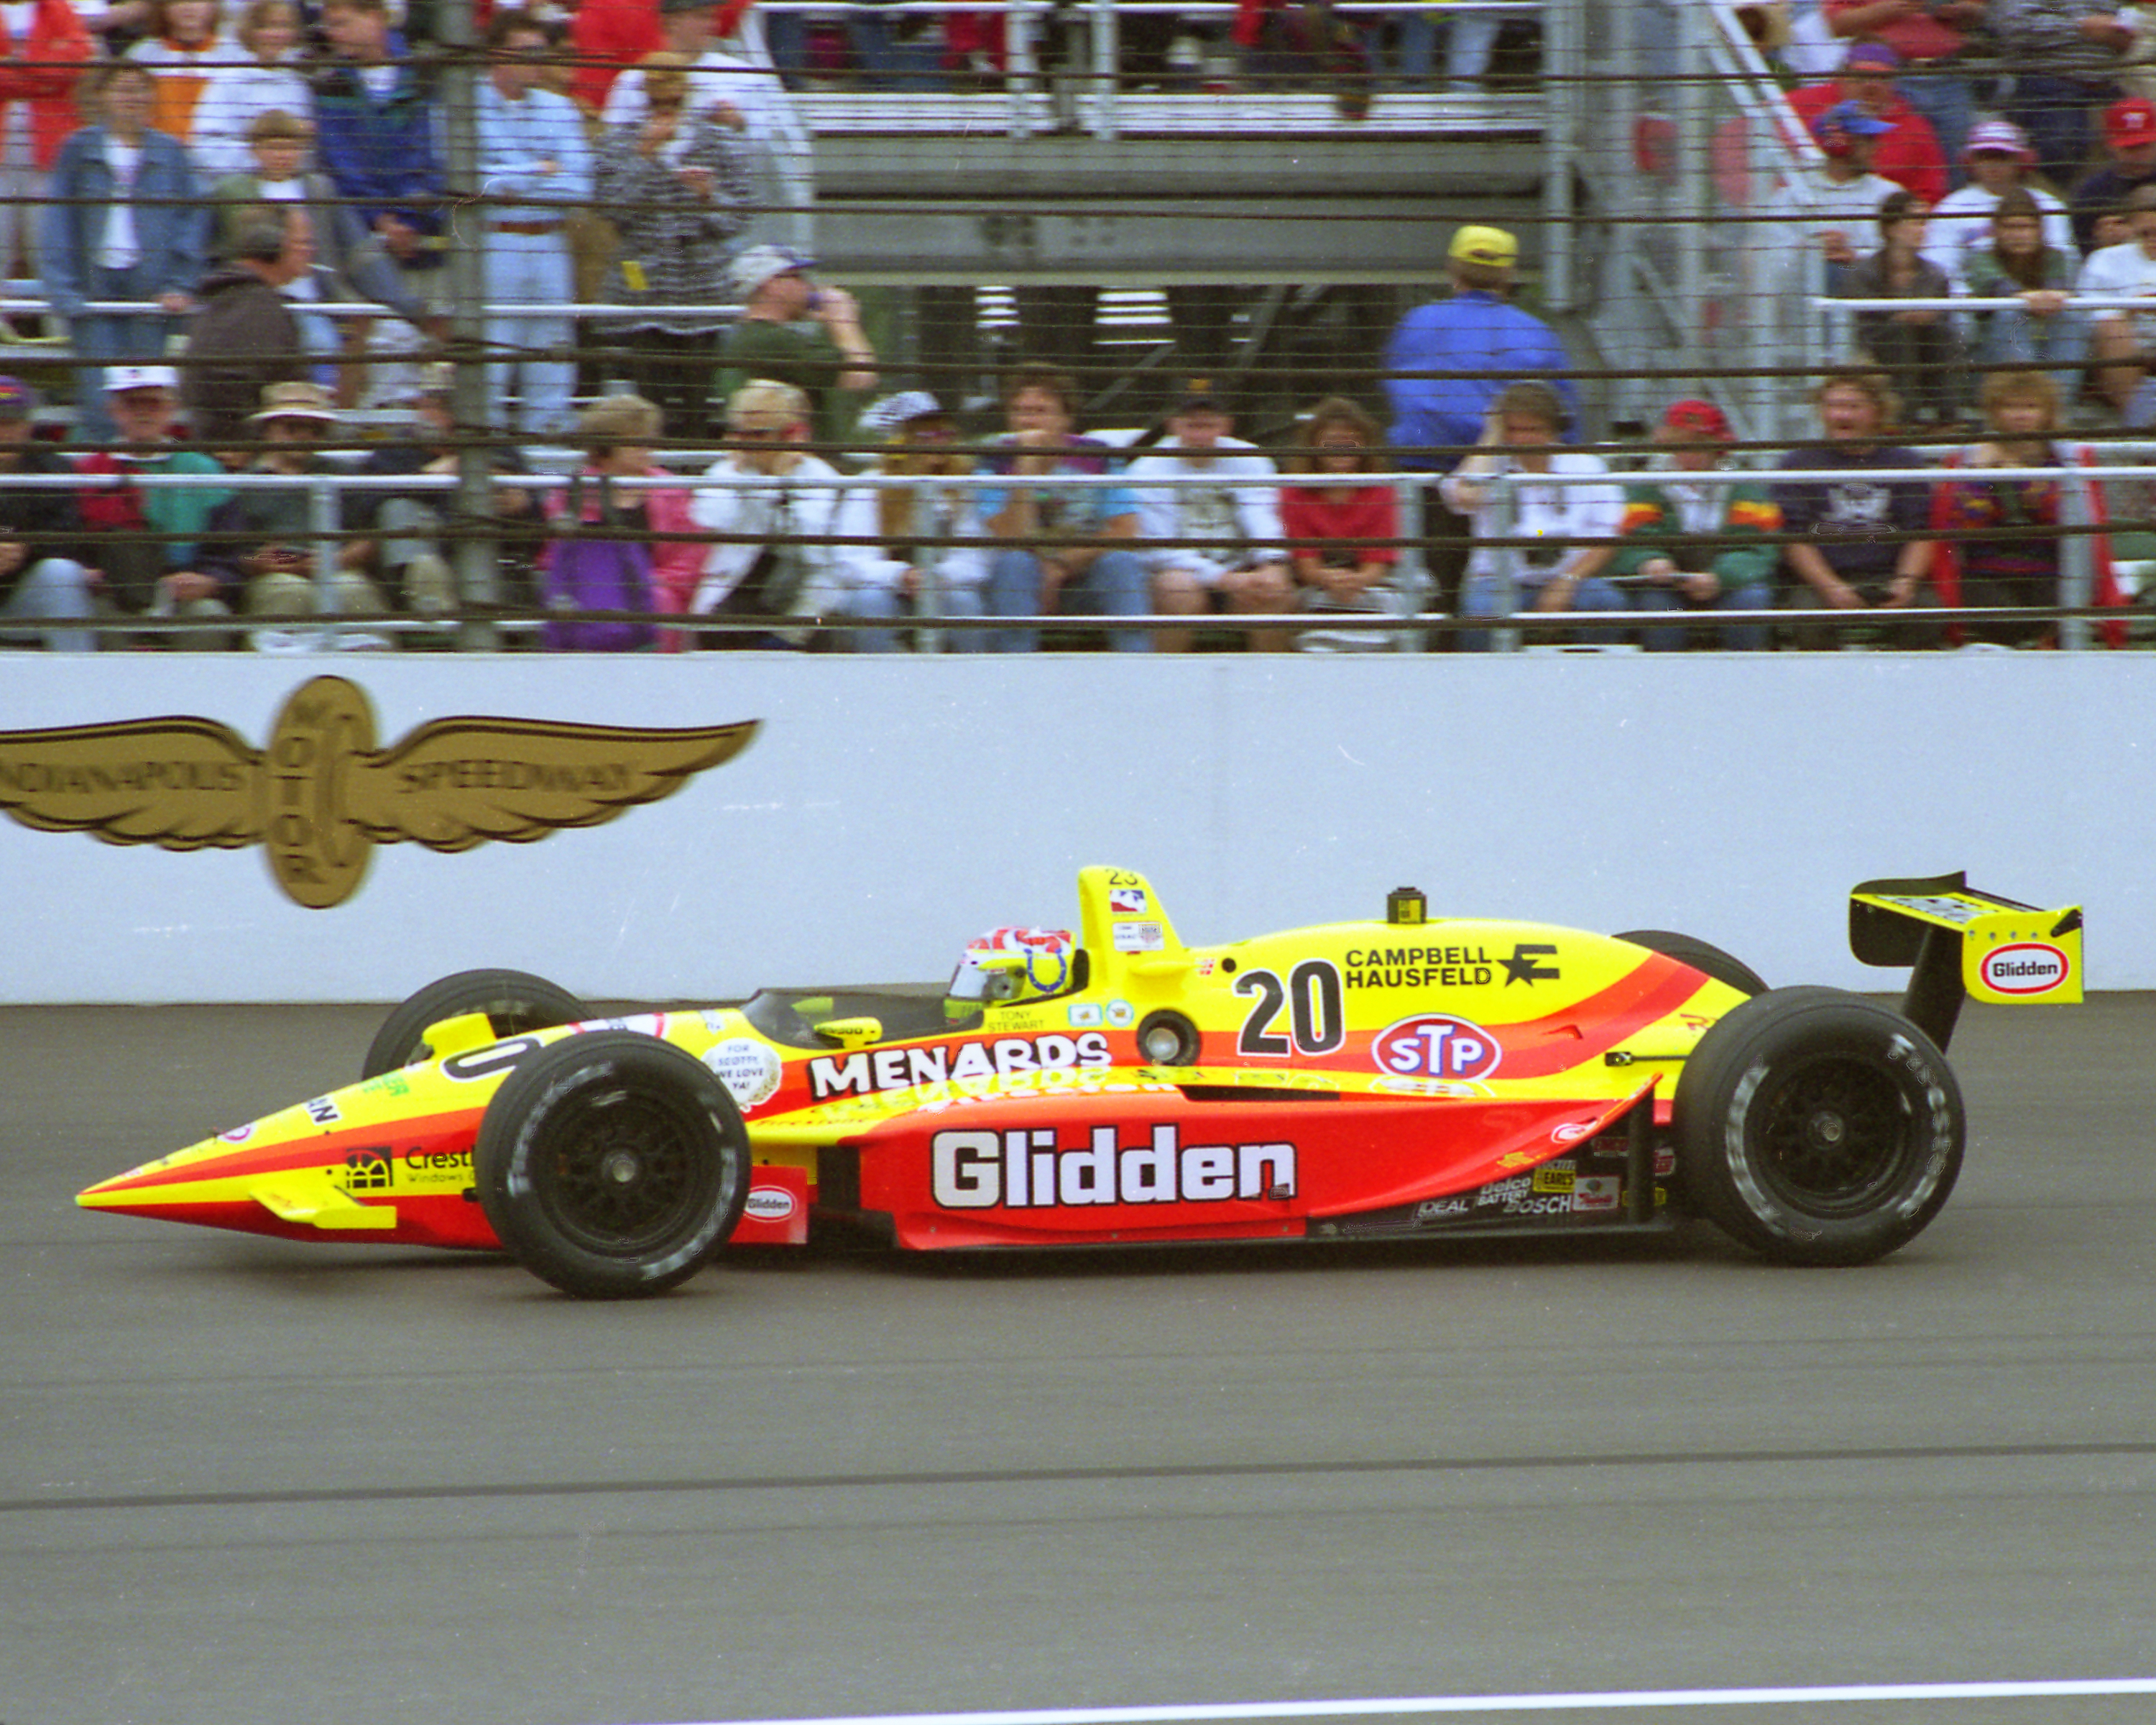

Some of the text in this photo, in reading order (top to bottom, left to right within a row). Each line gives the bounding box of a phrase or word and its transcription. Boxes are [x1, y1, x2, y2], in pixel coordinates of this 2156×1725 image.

[397, 758, 632, 794] SPEEDWAY
[1105, 868, 1138, 886] 23
[1345, 947, 1492, 967] CAMPBELL
[1345, 967, 1492, 988] HAUSFELD
[1992, 961, 2058, 978] Glidden
[1000, 1011, 1031, 1020] TONY
[1233, 958, 1345, 1057] 20
[987, 1019, 1044, 1032] STEWART
[727, 1044, 750, 1054] FOR
[1389, 1024, 1486, 1075] STP
[736, 1067, 764, 1078] LOVE
[807, 1031, 1113, 1101] MENARDS
[931, 1123, 1296, 1209] Glidden
[747, 1198, 790, 1210] Glidden
[1503, 1195, 1572, 1215] BOSCH
